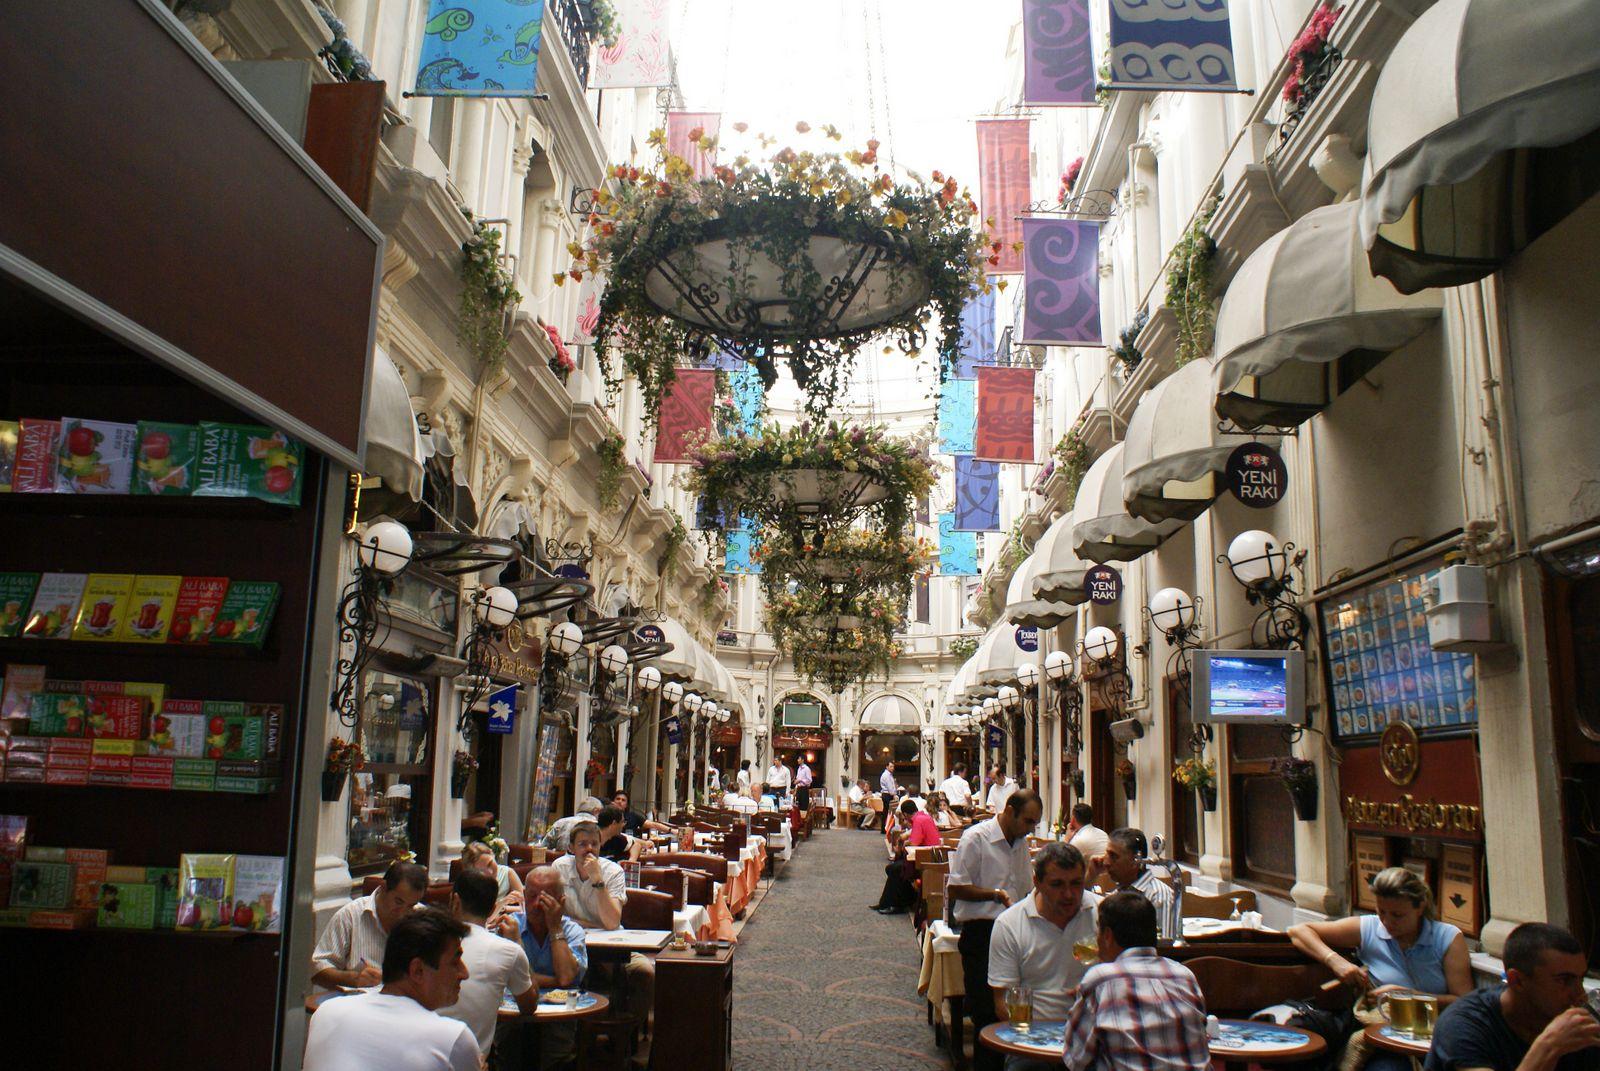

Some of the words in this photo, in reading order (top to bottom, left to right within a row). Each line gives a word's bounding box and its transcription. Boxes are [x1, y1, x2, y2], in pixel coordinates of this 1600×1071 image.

[20, 424, 41, 462] BABA
[201, 428, 221, 465] BABA
[1237, 468, 1277, 484] YENİ
[1240, 485, 1277, 499] RAKI
[199, 581, 224, 592] BABA
[246, 583, 273, 595] BABA
[1090, 581, 1116, 591] YENİ
[1092, 591, 1116, 600] RAKI
[179, 702, 199, 712] BABA
[219, 704, 240, 713] BABA
[267, 728, 277, 753] BABA
